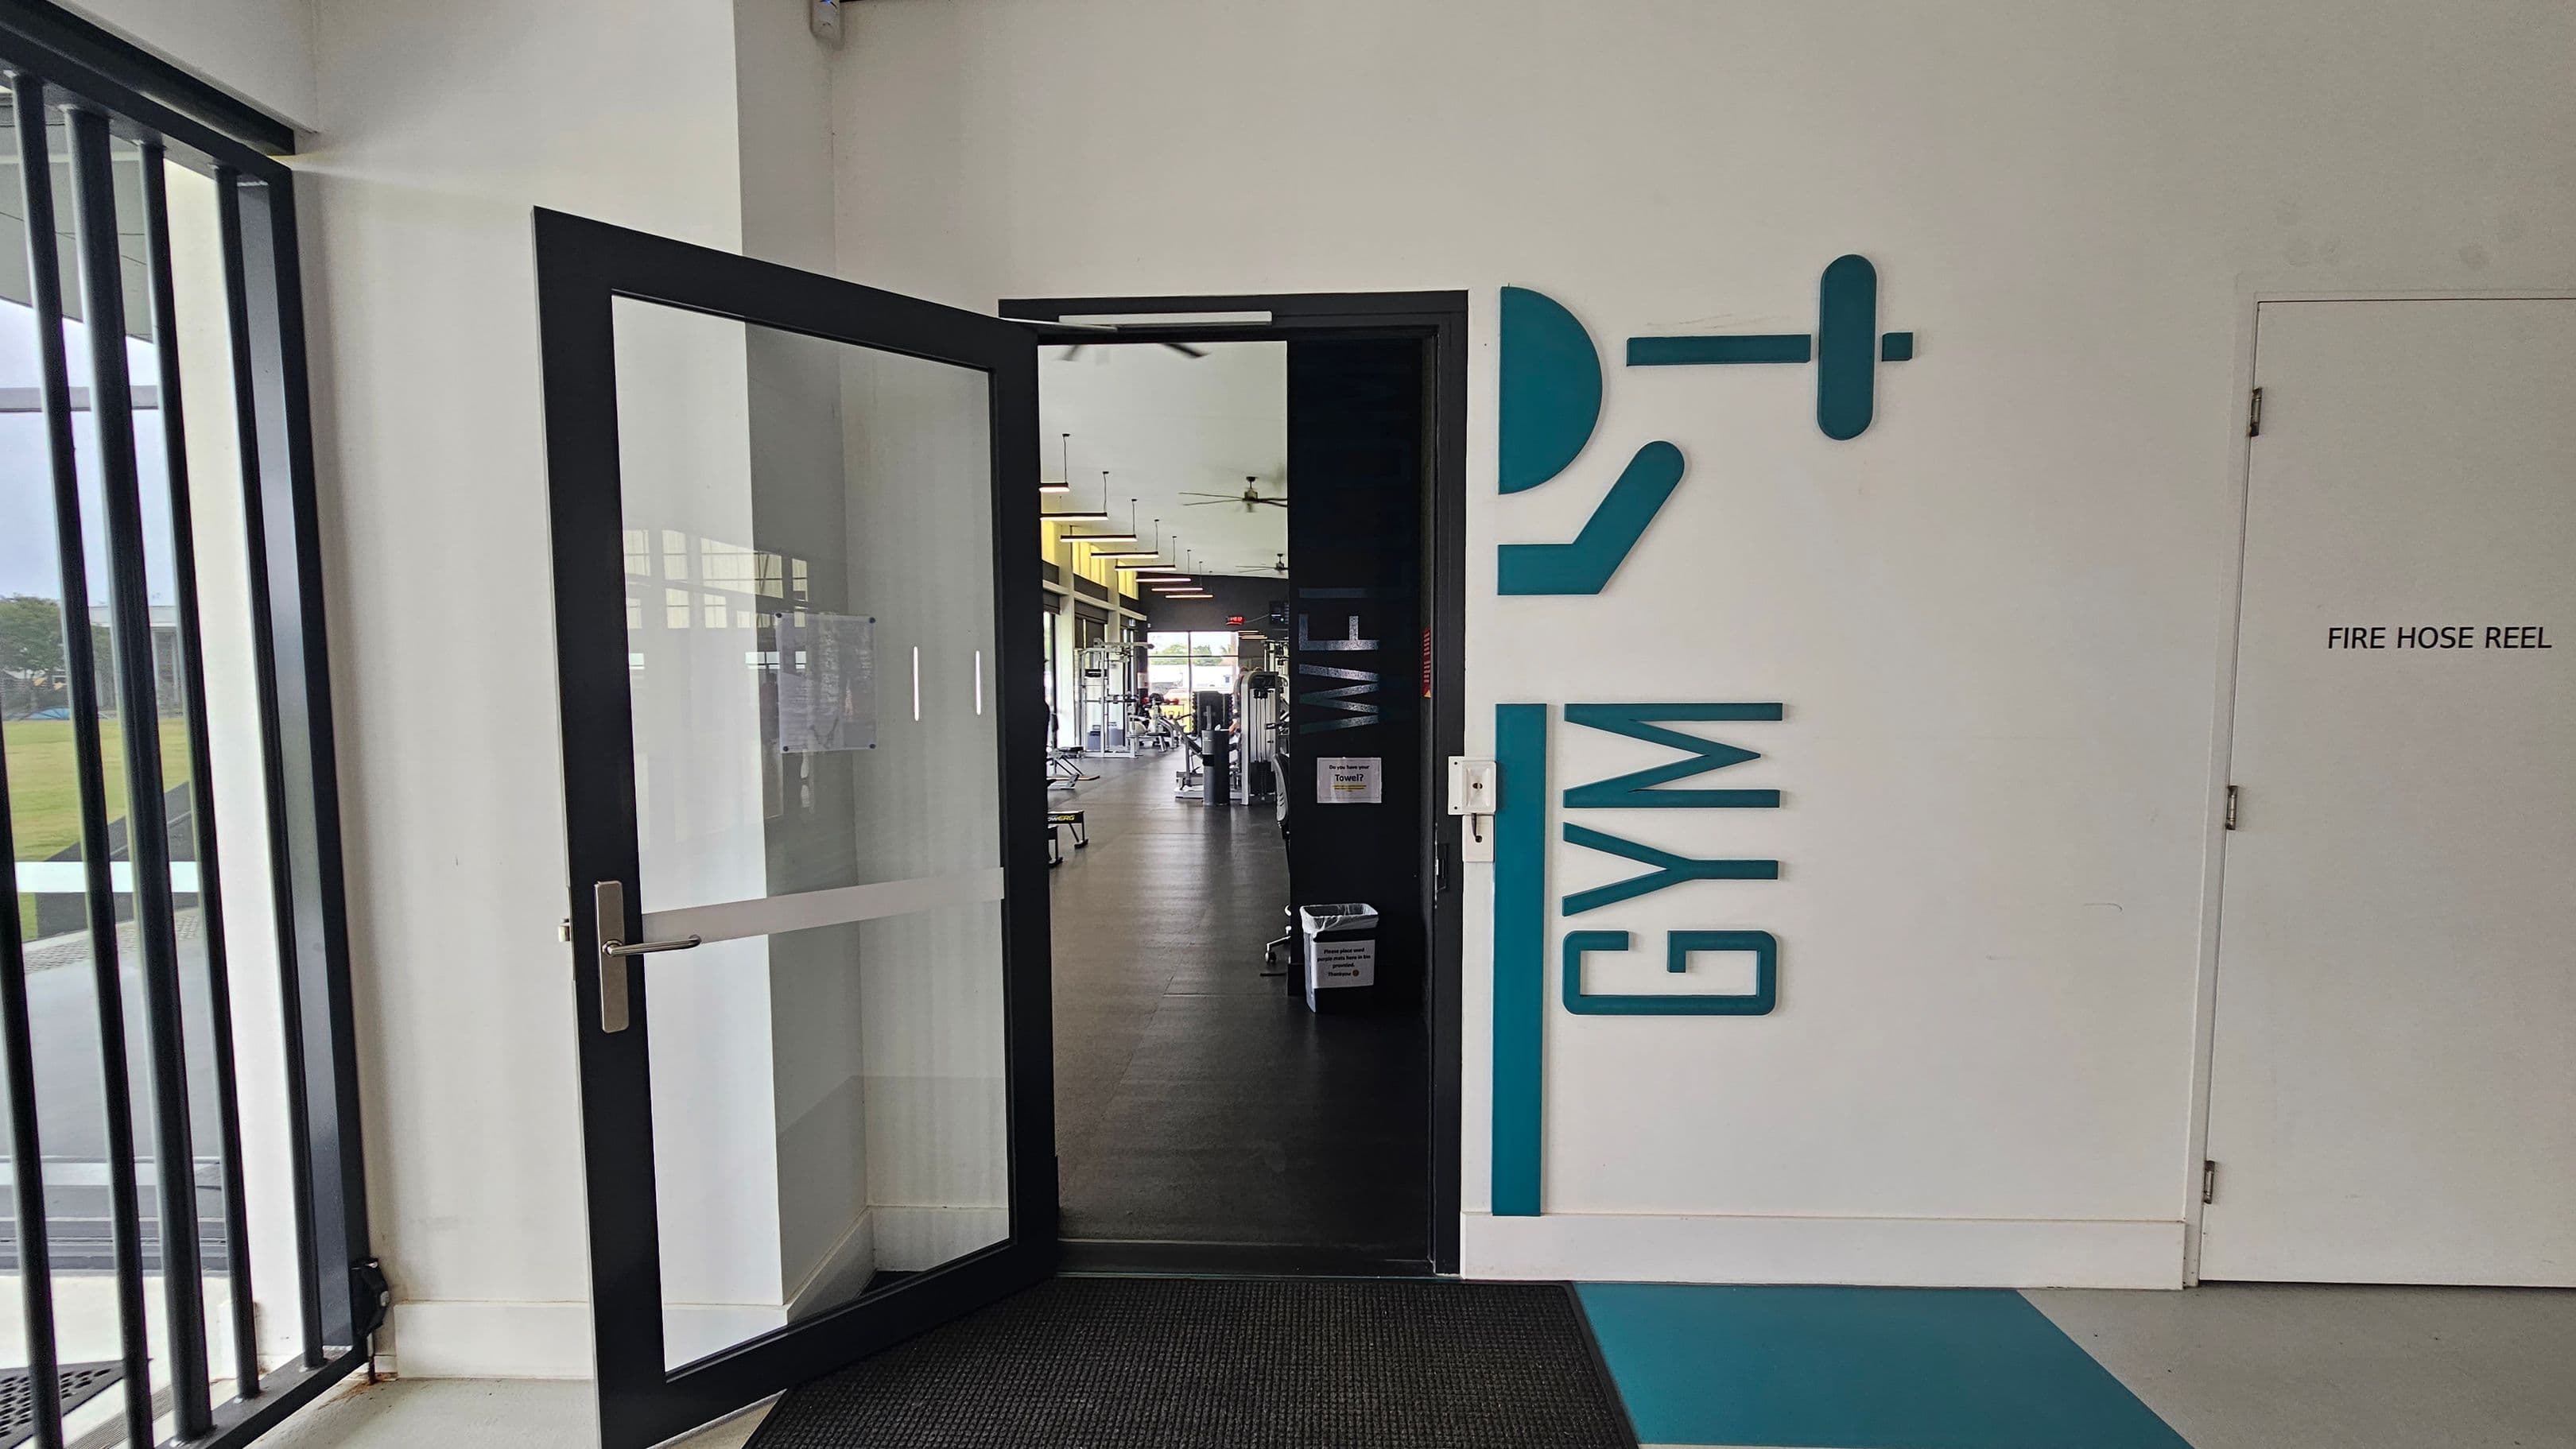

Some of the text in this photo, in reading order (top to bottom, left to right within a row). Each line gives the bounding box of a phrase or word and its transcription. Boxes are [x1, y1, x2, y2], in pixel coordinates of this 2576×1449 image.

[2328, 626, 2552, 649] FIRE HOSE REEL
[1562, 703, 1783, 1016] GYM
